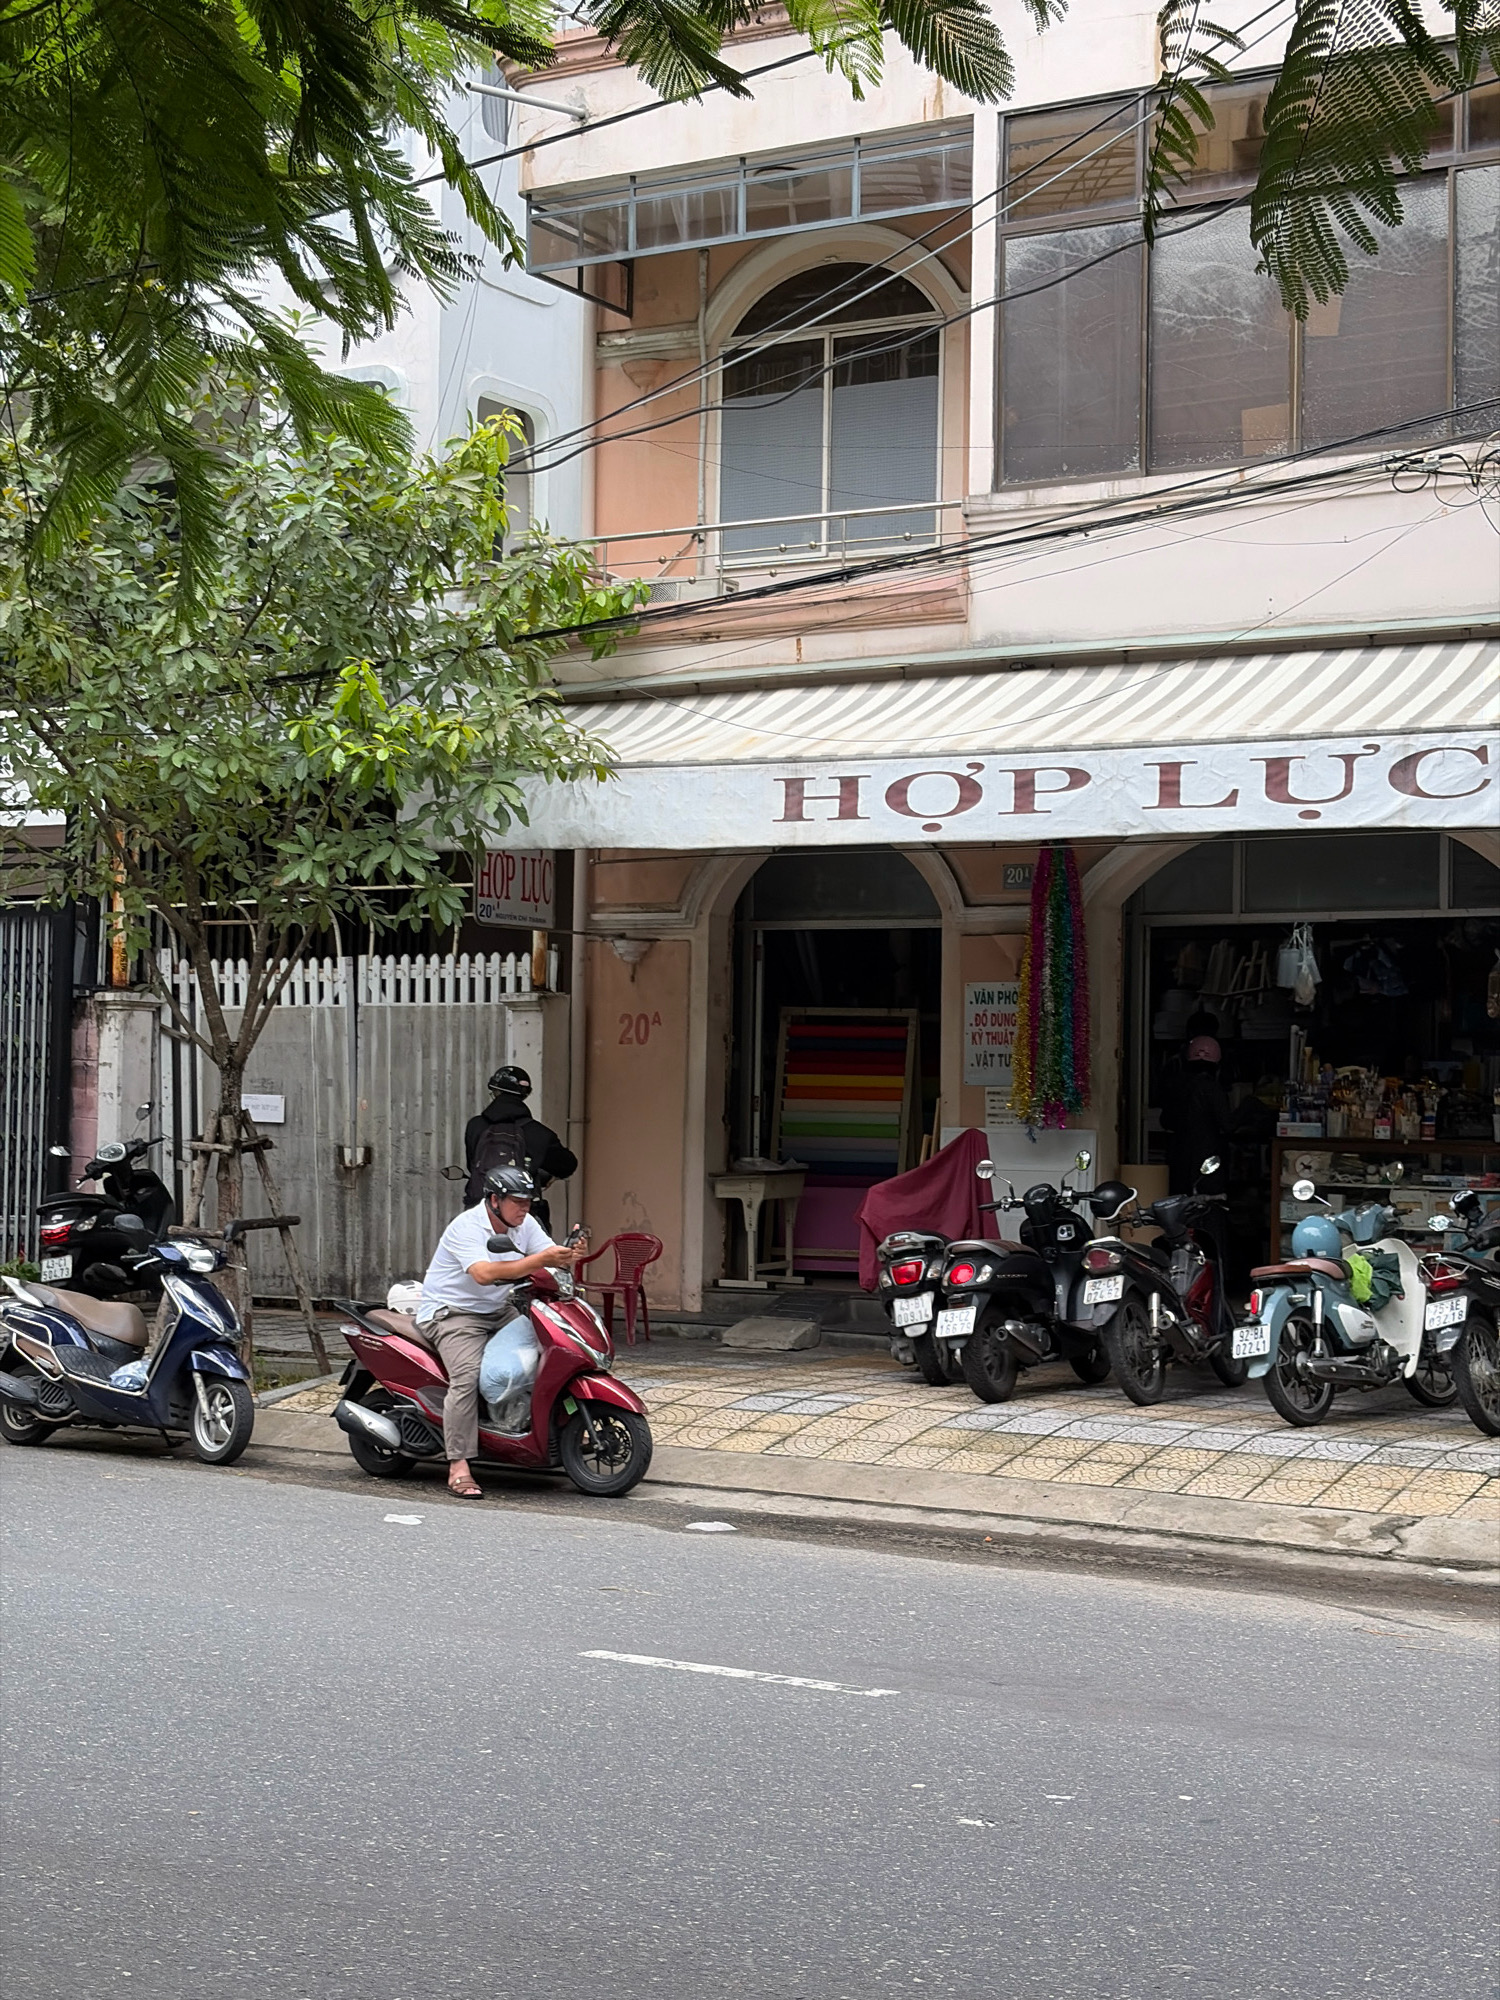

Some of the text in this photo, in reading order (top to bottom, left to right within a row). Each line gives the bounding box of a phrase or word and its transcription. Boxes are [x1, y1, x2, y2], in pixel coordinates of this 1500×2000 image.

[772, 743, 1493, 833] HỢP LỰC
[478, 849, 552, 913] HỢP LỰC
[997, 986, 1019, 1005] PHÒ
[618, 1010, 662, 1046] 20A
[990, 1009, 1017, 1028] DÙNG
[985, 1029, 1015, 1048] THUẬT
